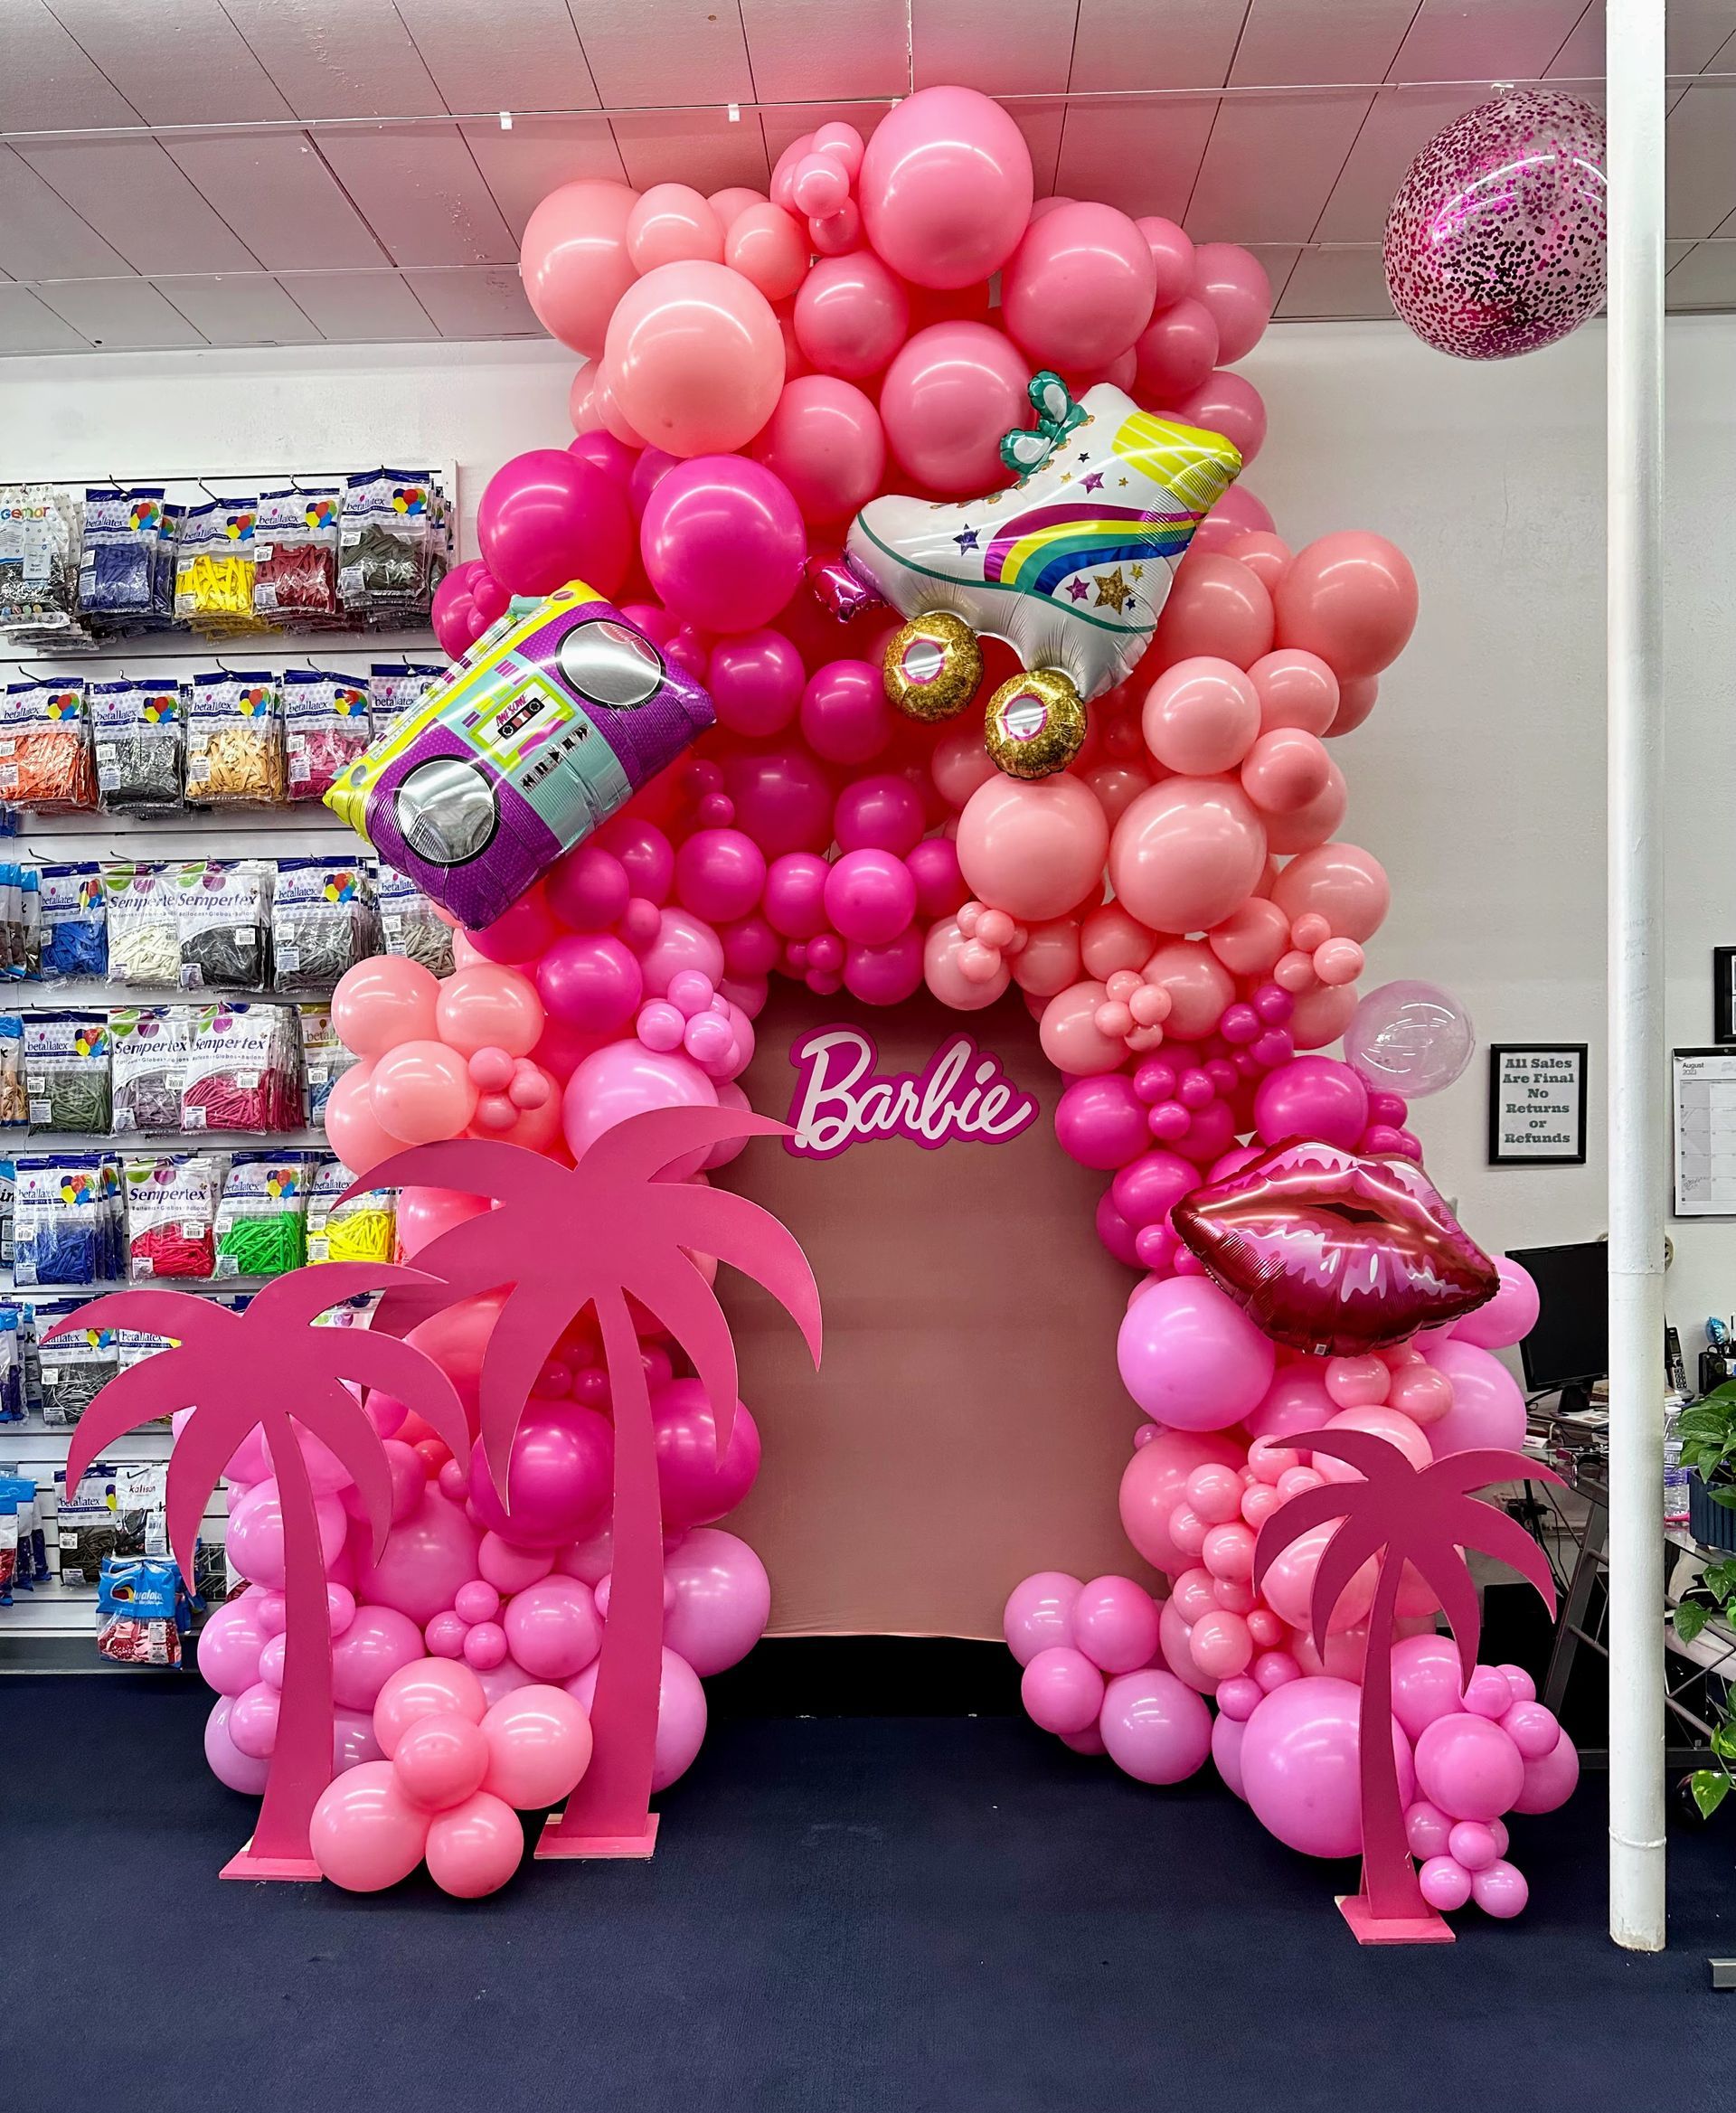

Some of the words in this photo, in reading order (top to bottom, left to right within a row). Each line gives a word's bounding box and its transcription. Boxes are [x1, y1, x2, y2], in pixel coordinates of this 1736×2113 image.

[288, 701, 328, 712] betallatex
[495, 693, 527, 727] AWESOME
[4, 707, 39, 719] betallatex
[97, 709, 137, 721] betallatex
[382, 881, 414, 891] betallate
[278, 887, 316, 899] betallatex
[108, 894, 175, 911] Semperte
[177, 892, 257, 910] Sempertex
[27, 1041, 68, 1051] betallatex
[115, 1040, 187, 1056] Sempertex
[193, 1037, 266, 1053] Sempertex
[1505, 1059, 1527, 1068] All
[1531, 1058, 1572, 1068] Sales
[1503, 1074, 1530, 1083] Are
[1533, 1073, 1574, 1083] Final
[795, 1031, 1032, 1151] Barbie
[1527, 1089, 1549, 1098] No
[1505, 1104, 1570, 1113] Returns
[1505, 1133, 1571, 1143] Refunds
[129, 1187, 206, 1204] Sempertex
